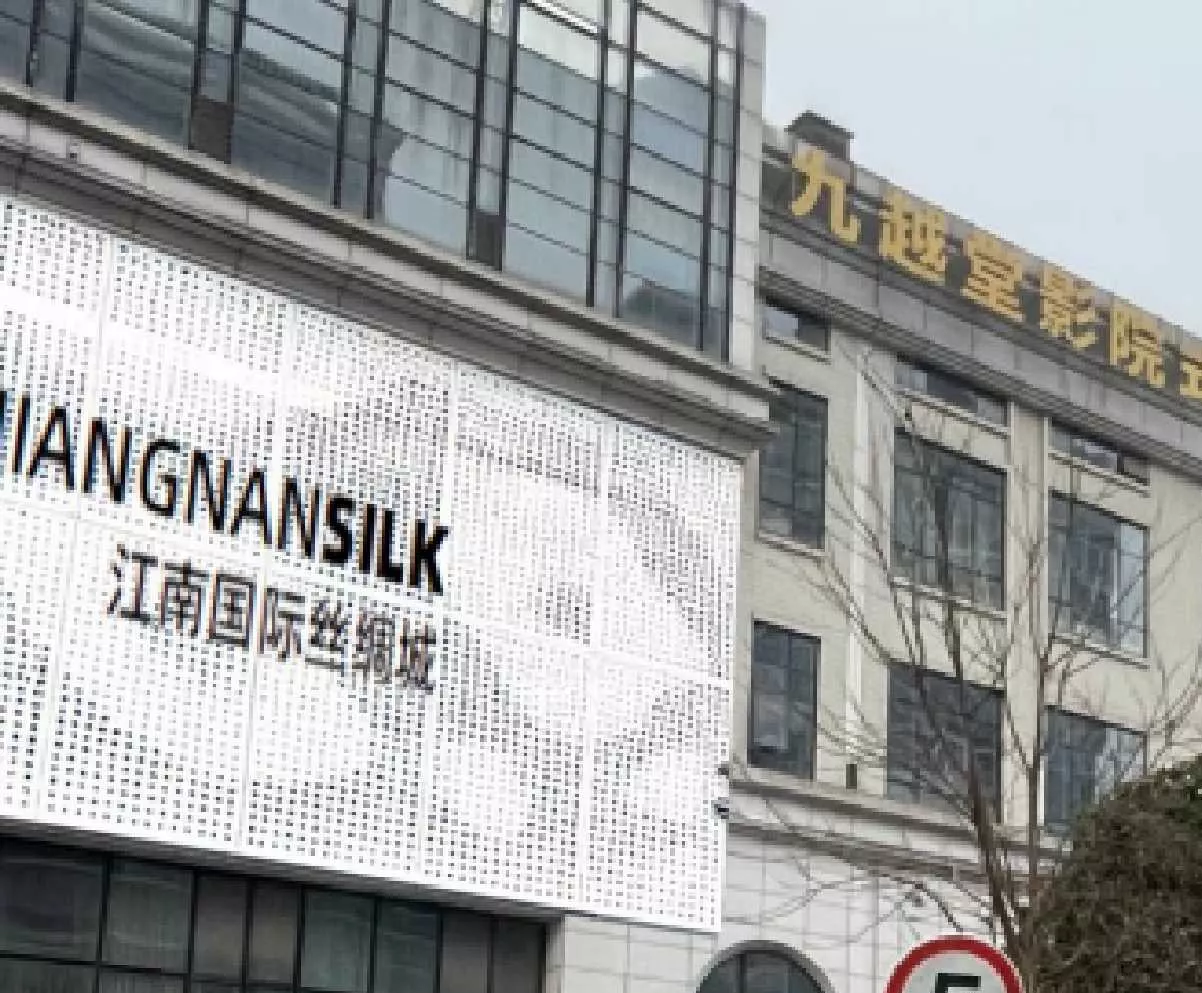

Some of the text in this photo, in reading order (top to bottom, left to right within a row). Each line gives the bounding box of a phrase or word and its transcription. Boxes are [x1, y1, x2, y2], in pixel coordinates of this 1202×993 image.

[106, 544, 437, 694] 江南国际丝绸城
